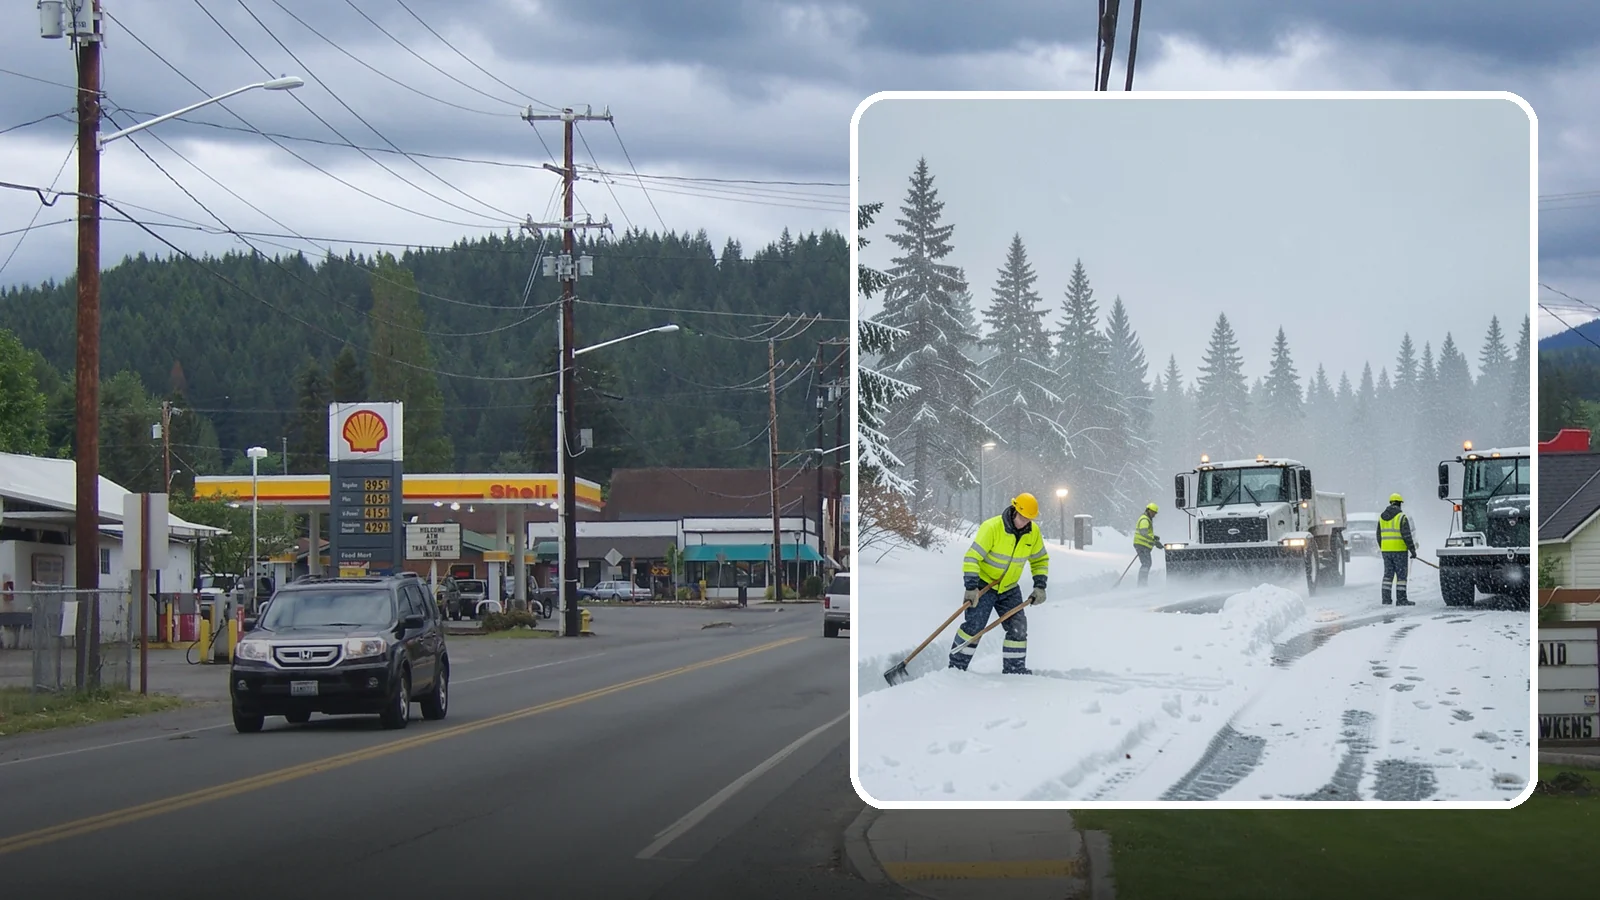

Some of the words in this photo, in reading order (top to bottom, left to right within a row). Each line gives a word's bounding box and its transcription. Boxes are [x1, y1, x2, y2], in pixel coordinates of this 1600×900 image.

[366, 480, 384, 490] 395
[490, 484, 547, 498] Shell
[366, 494, 384, 504] 405
[366, 508, 384, 518] 415
[366, 522, 384, 532] 429
